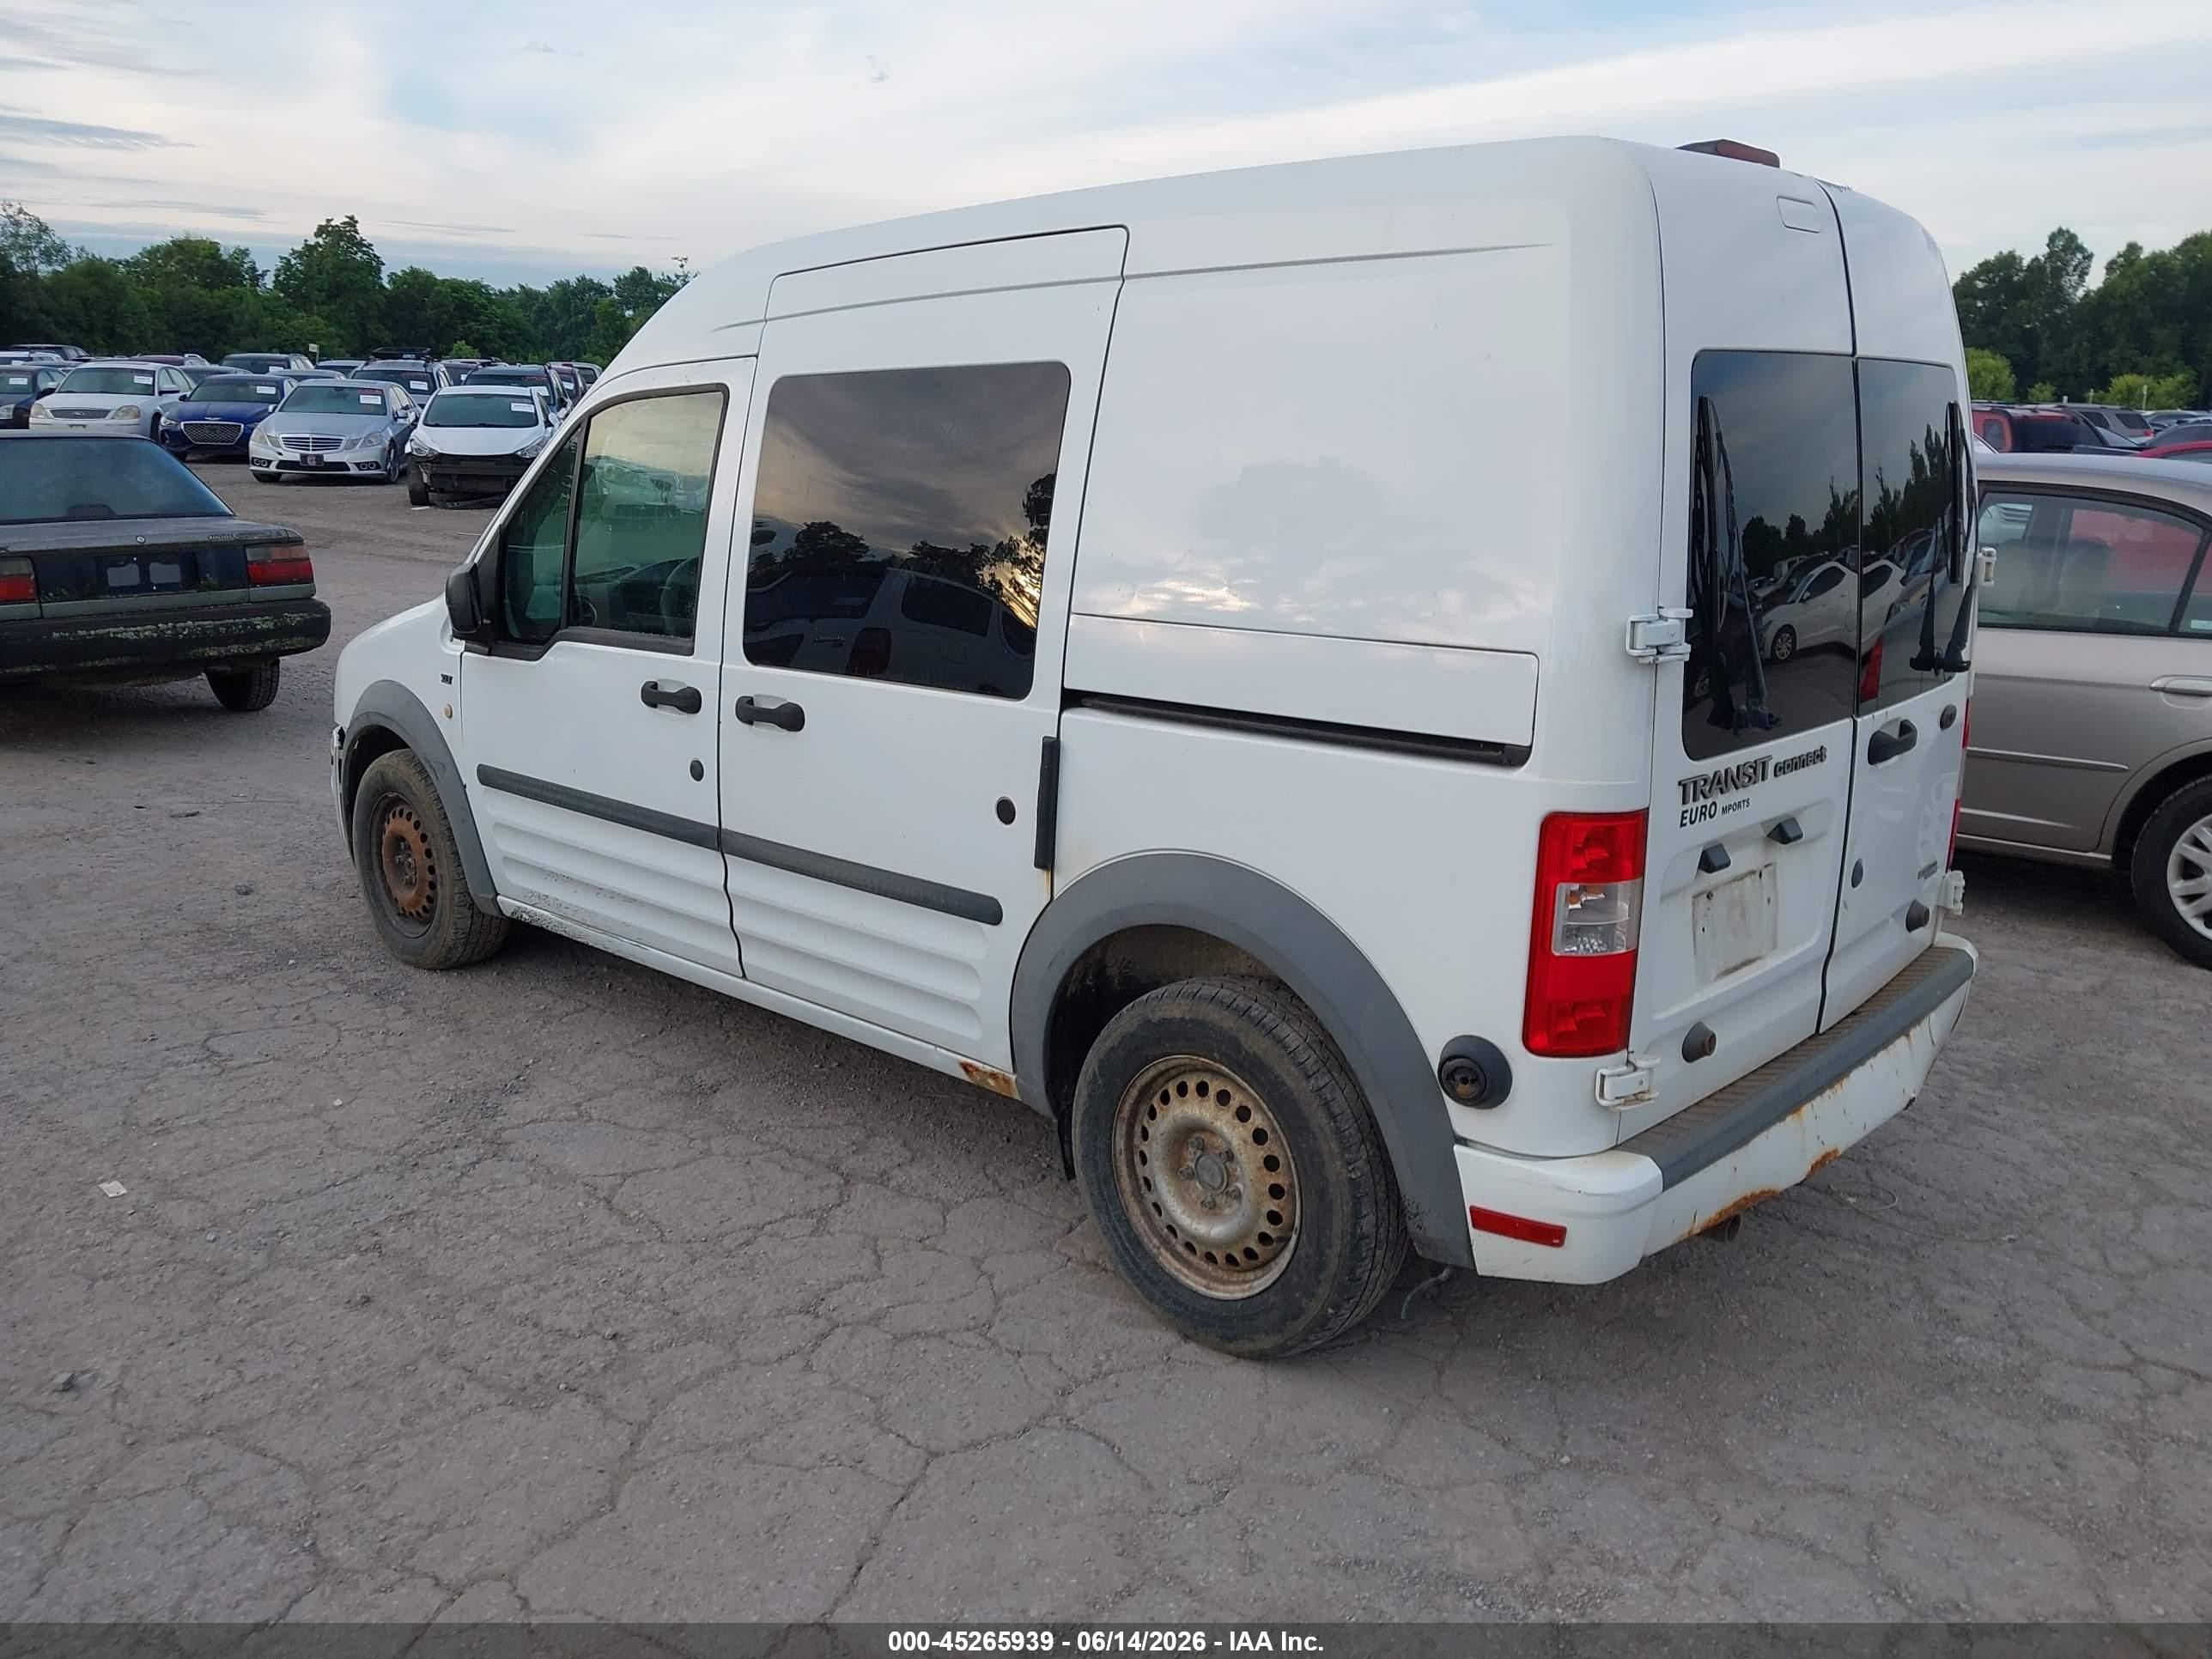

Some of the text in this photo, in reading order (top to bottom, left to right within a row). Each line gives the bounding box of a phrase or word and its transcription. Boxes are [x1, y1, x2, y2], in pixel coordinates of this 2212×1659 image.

[1678, 745, 1827, 805] TRANSIT connect
[1680, 798, 1751, 829] EURO MPORTS
